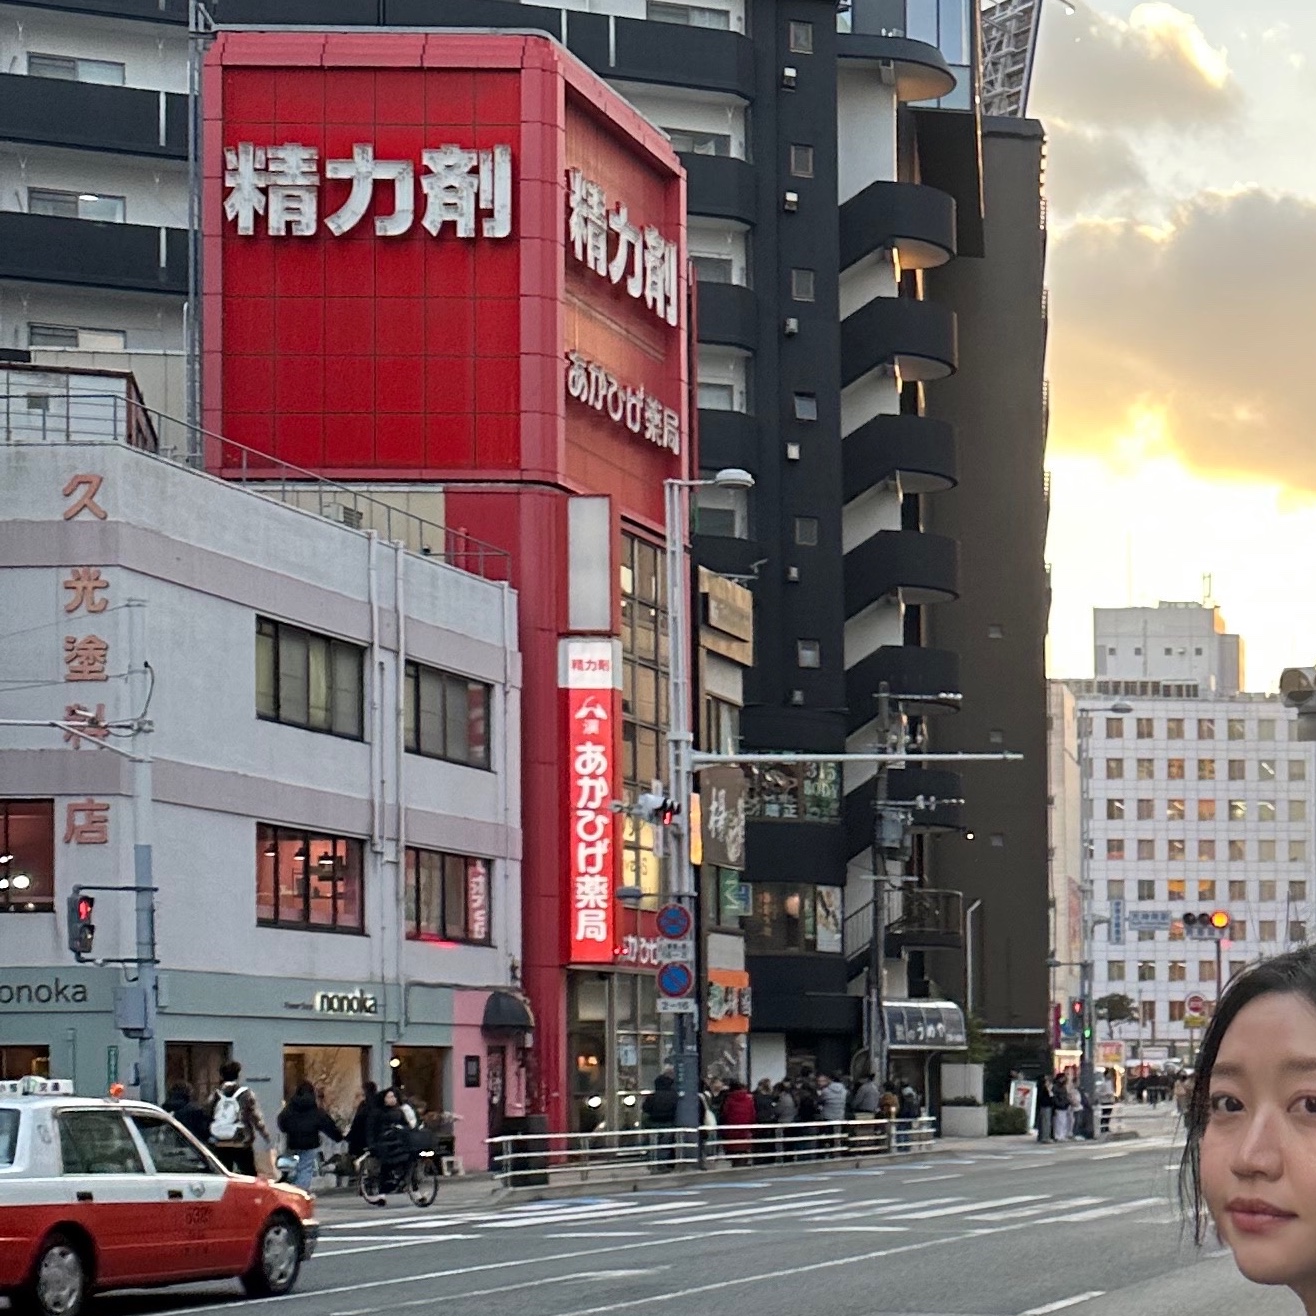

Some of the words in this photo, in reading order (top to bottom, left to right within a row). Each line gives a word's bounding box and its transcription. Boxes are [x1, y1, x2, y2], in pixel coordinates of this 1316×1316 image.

[223, 142, 511, 238] 精力剤
[569, 166, 678, 327] 精力剤
[568, 350, 681, 455] あかひげ薬局
[574, 740, 610, 942] あかひげ薬局
[320, 988, 378, 1013] nonoka
